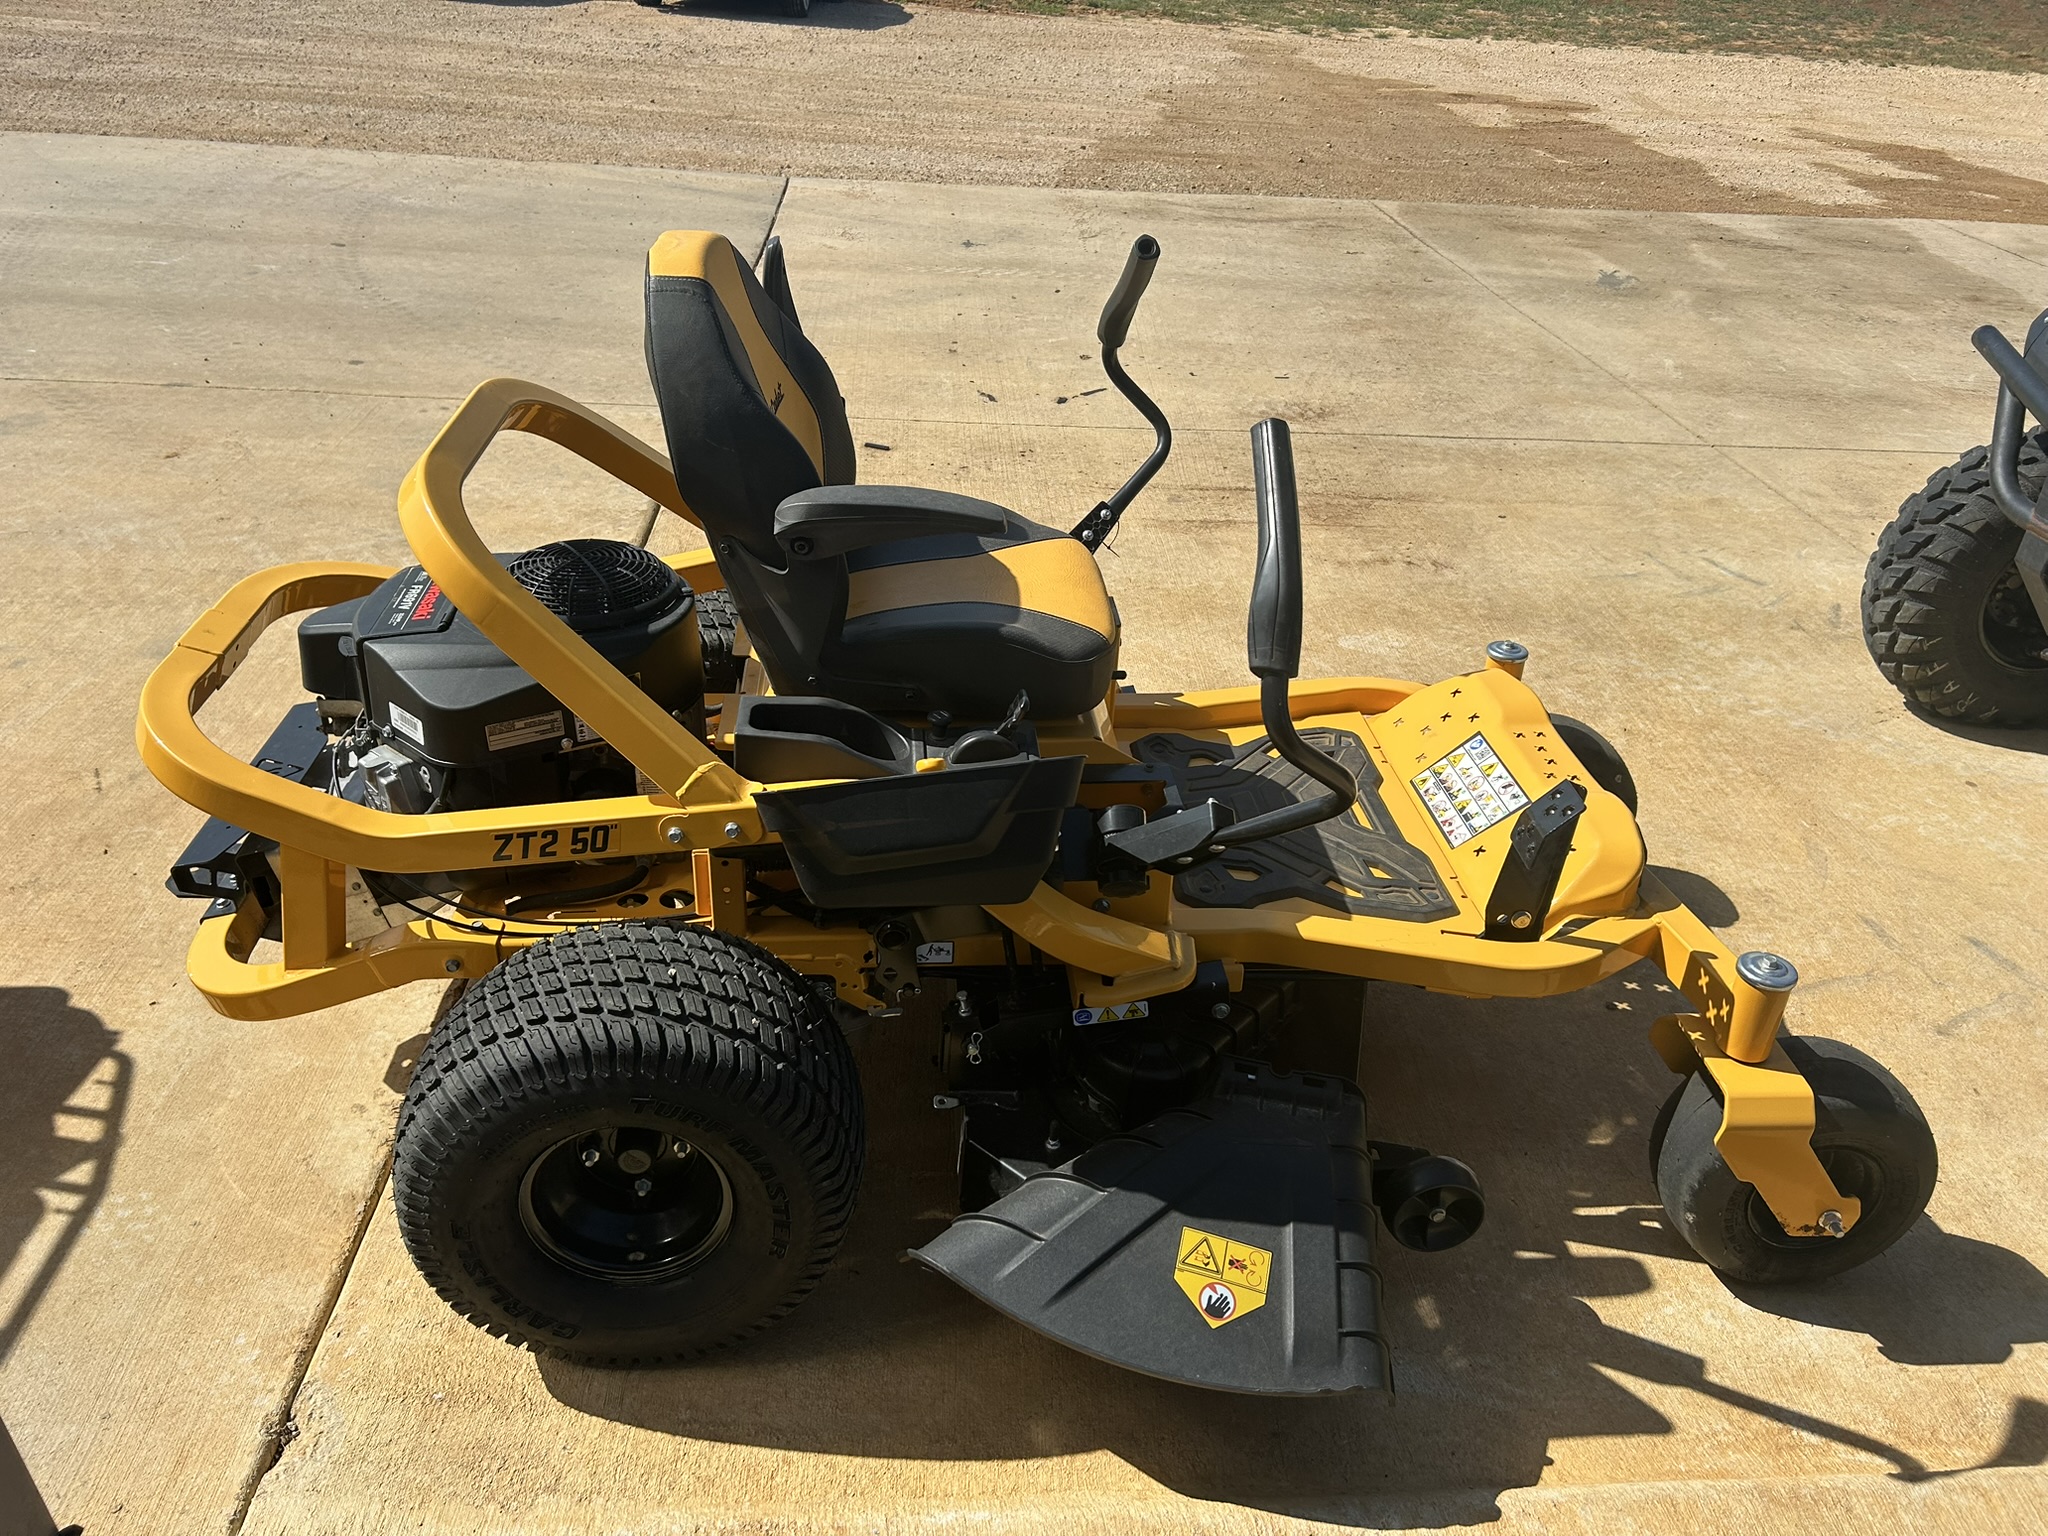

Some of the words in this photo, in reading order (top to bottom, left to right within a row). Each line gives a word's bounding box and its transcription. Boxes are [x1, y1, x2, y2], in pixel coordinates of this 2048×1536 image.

[411, 582, 441, 620] wasaki
[492, 830, 559, 862] ZT2
[570, 823, 618, 855] 50"
[628, 1095, 734, 1136] TURF
[728, 1134, 794, 1262] MASTER
[448, 1219, 583, 1340] CARLISLE
